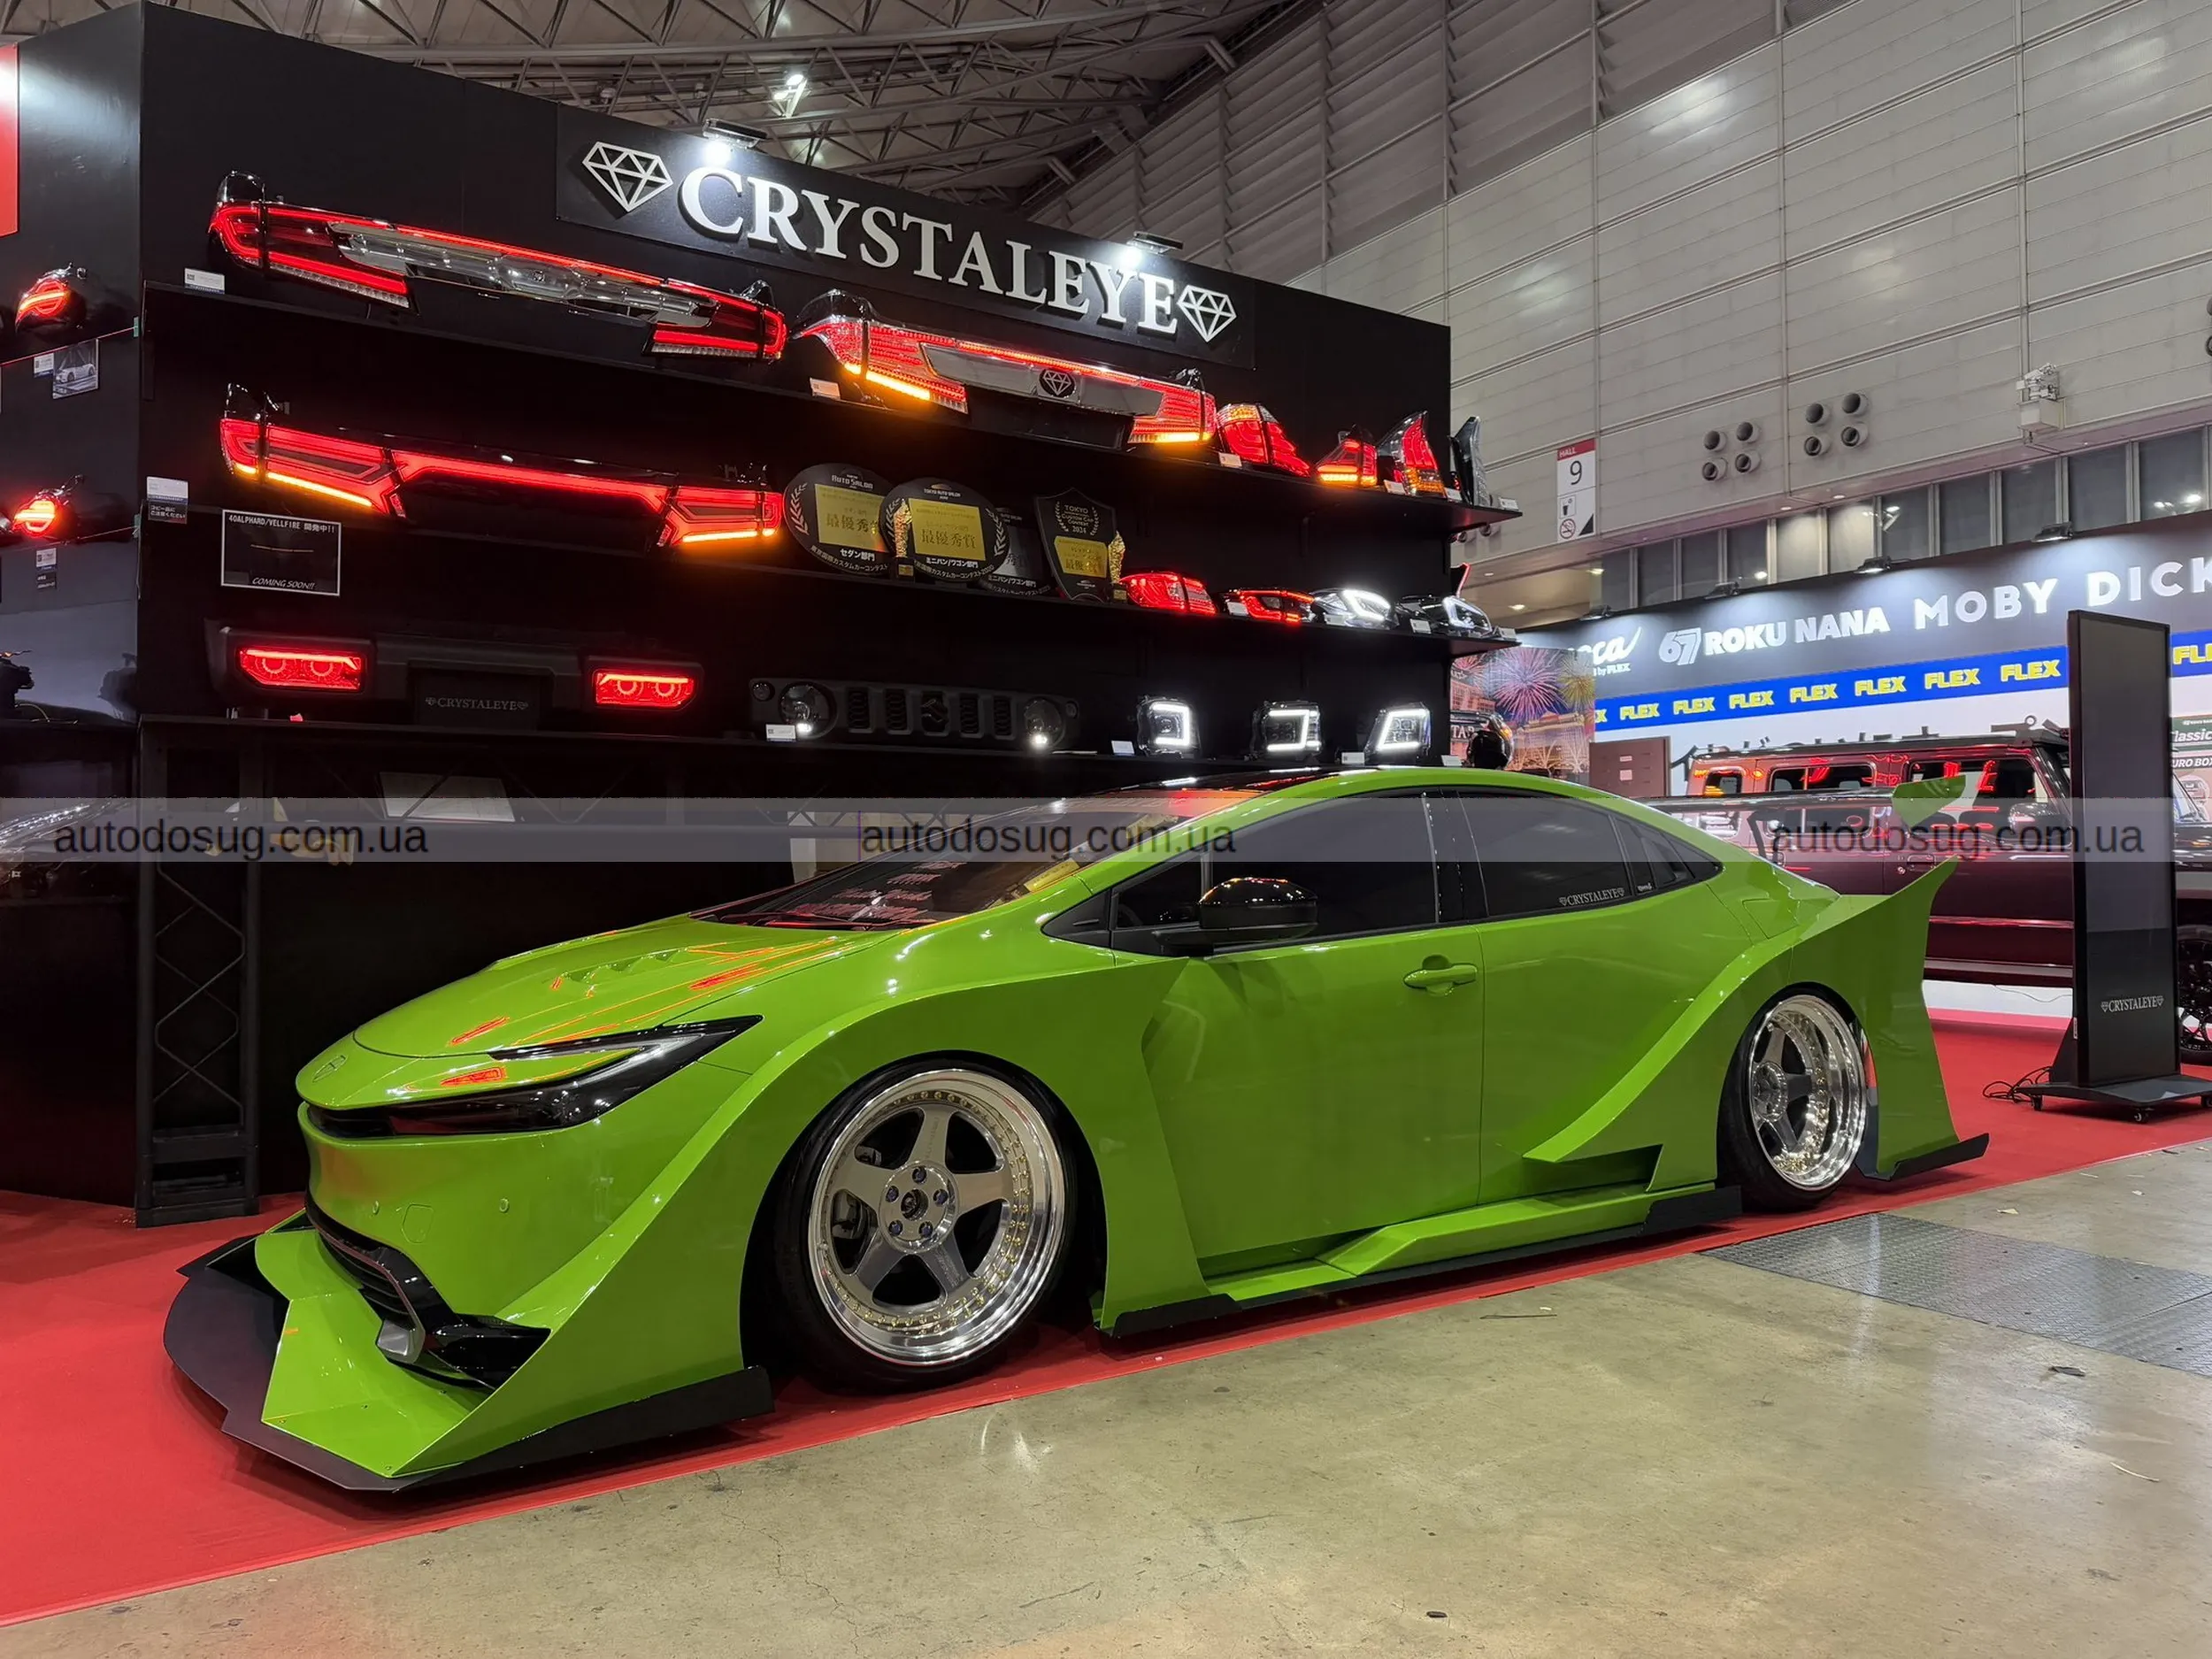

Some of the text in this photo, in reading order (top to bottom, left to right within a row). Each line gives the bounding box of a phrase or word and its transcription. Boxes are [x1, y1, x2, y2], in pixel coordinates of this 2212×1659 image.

[680, 166, 1179, 334] CRYSTALEYE
[1559, 448, 1576, 458] HALL
[1570, 460, 1582, 485] 9
[1064, 504, 1088, 514] TOKYO
[840, 548, 875, 562] セダン部門
[252, 577, 287, 588] COMING
[1914, 557, 2212, 630] MOBY DICK
[1704, 622, 1787, 656] ROKU
[1794, 607, 1891, 643] NANA
[1607, 663, 1632, 674] FLEX
[1619, 703, 1660, 721] FLEX
[1673, 696, 1715, 715] FLEX
[1729, 690, 1774, 709] FLEX
[1790, 683, 1838, 703] FLEX
[1855, 675, 1906, 696] FLEX
[1924, 668, 1980, 689] FLEX
[2000, 659, 2061, 681] FLEX
[437, 697, 518, 710] CRYSTALEYE
[2170, 728, 2212, 742] lassic
[2171, 757, 2193, 768] URO
[1566, 887, 1619, 906] CRYSTALEYE
[2108, 995, 2158, 1012] CRYSTALEYE
